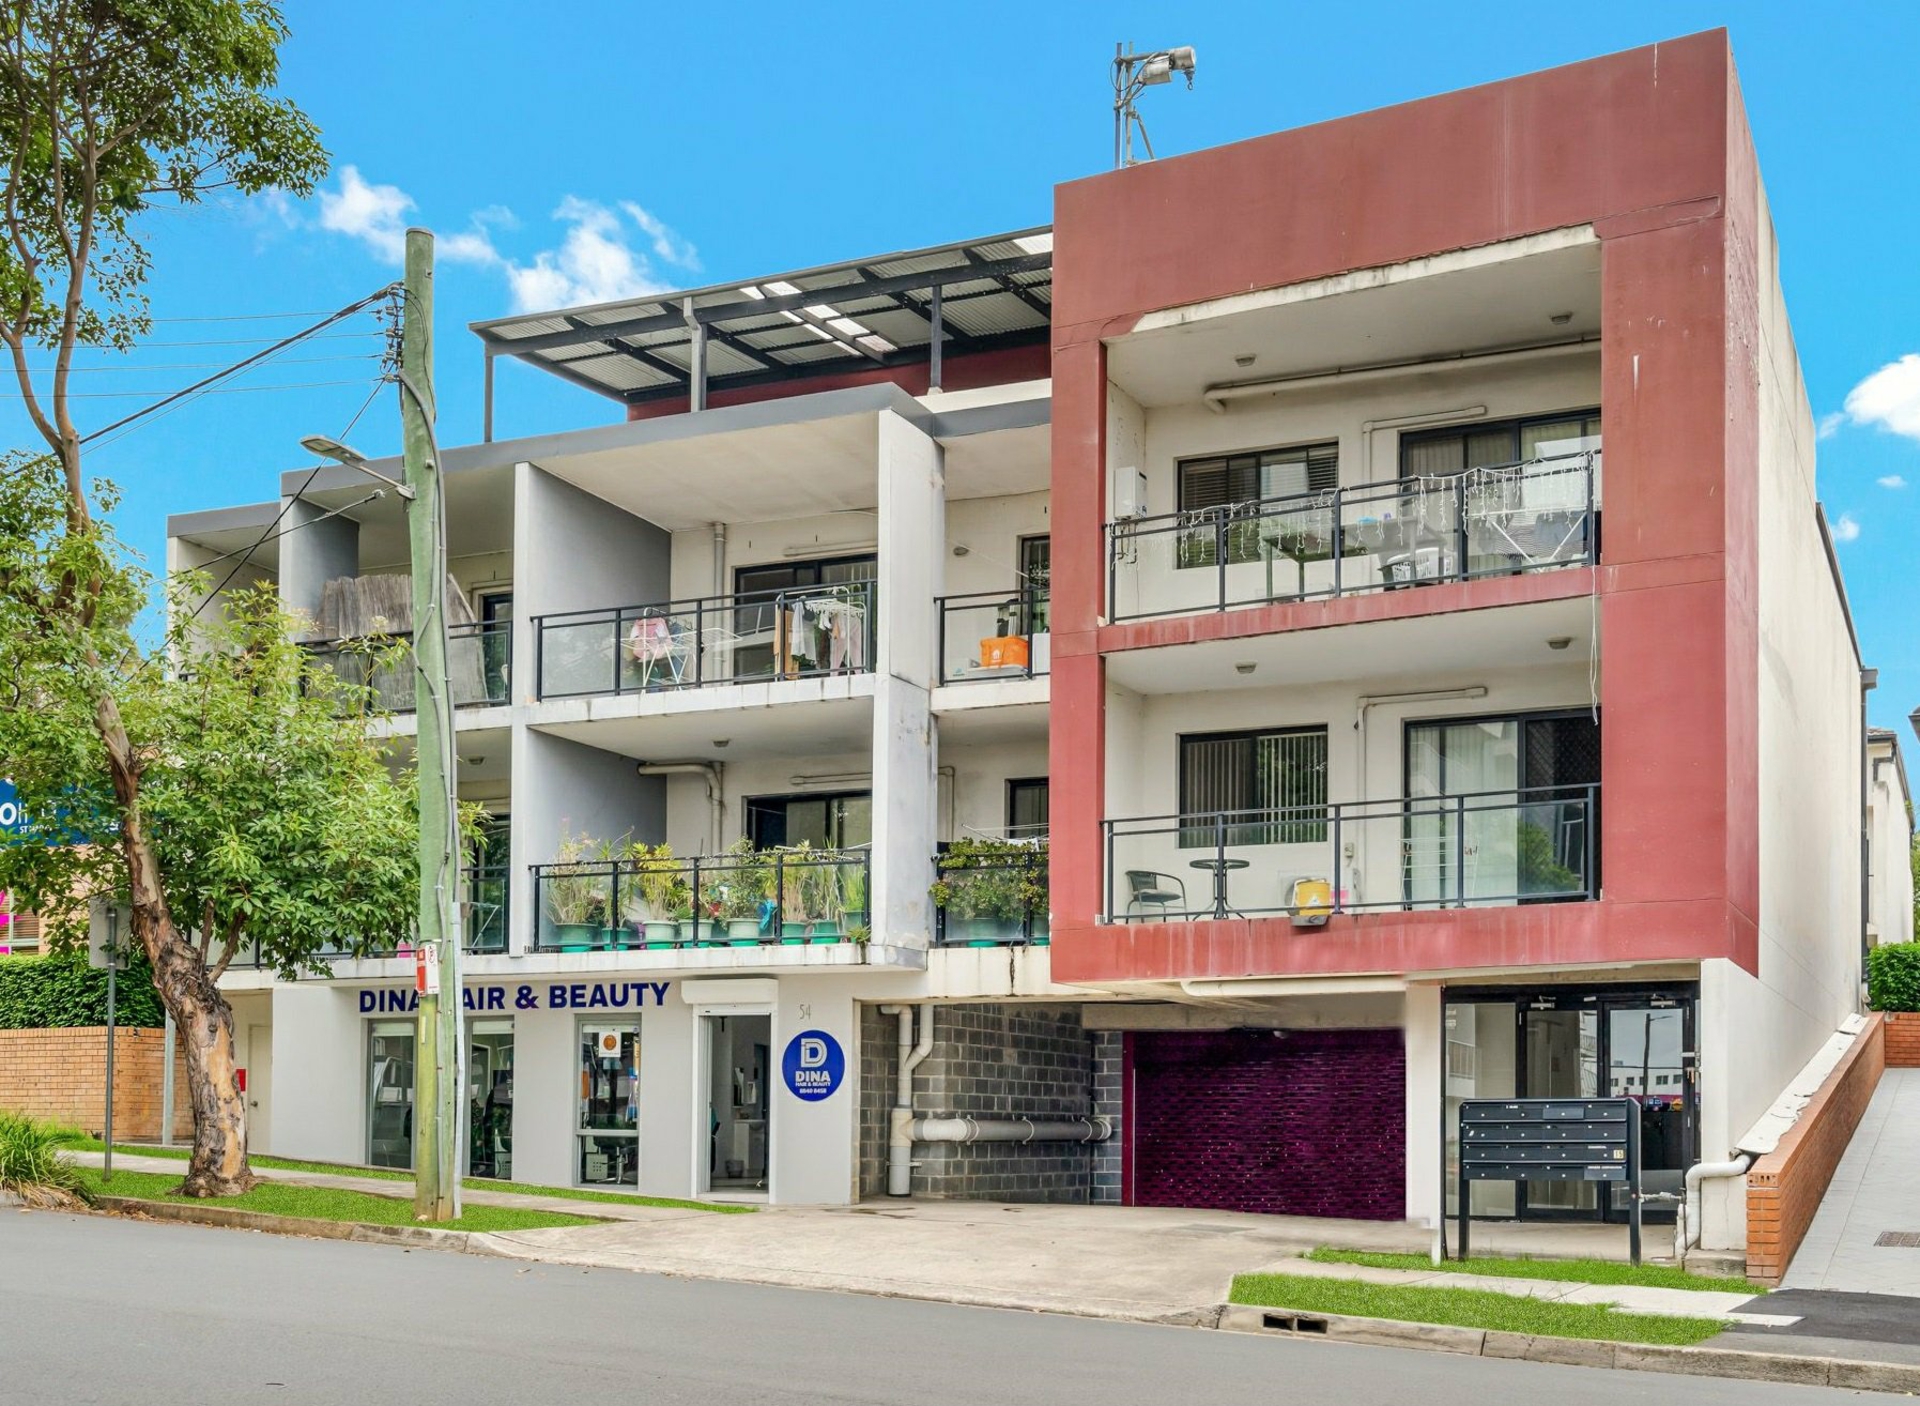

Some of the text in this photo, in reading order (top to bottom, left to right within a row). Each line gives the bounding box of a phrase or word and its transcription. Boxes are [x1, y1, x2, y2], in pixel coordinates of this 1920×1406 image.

[463, 987, 506, 1011] AIR
[514, 985, 540, 1010] &
[549, 982, 671, 1009] BEAUTY
[799, 1003, 811, 1020] 54
[801, 1038, 827, 1067] D
[795, 1070, 831, 1082] DINA
